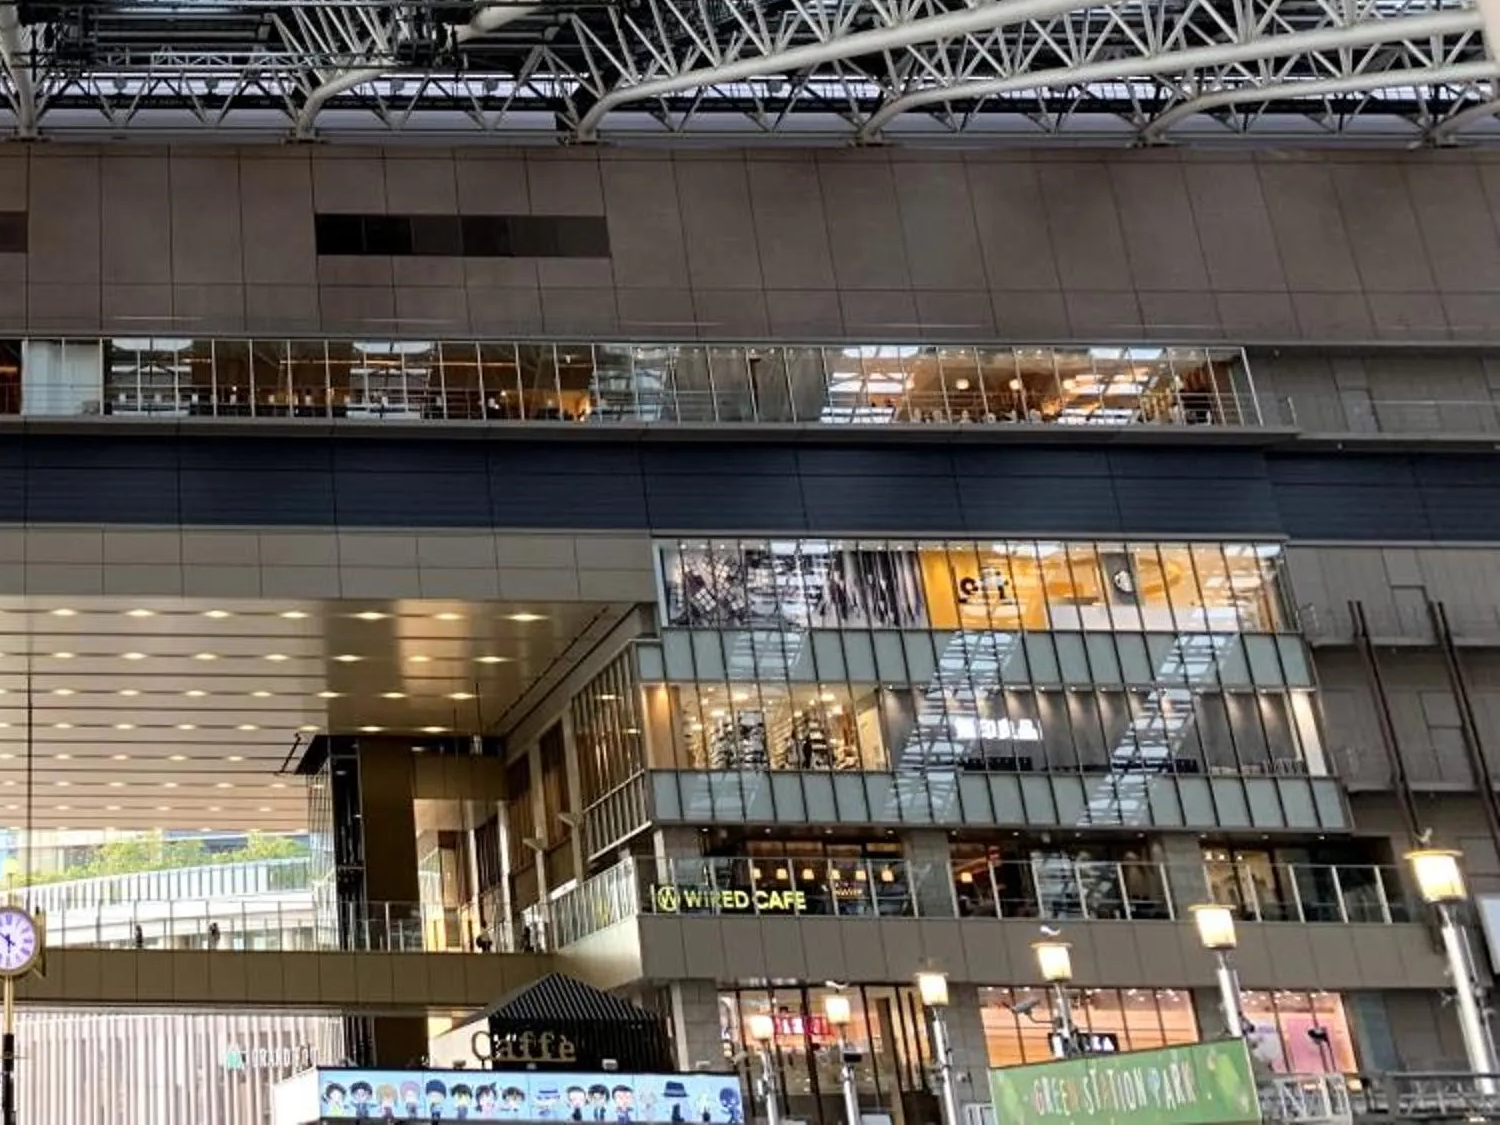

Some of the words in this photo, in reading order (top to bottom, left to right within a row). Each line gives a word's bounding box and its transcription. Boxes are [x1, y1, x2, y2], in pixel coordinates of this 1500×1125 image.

[684, 889, 749, 909] WIRED
[753, 889, 807, 910] CAFE
[1032, 1075, 1081, 1117] GREEN
[1082, 1067, 1148, 1116] STATION
[1147, 1059, 1197, 1112] PARK
